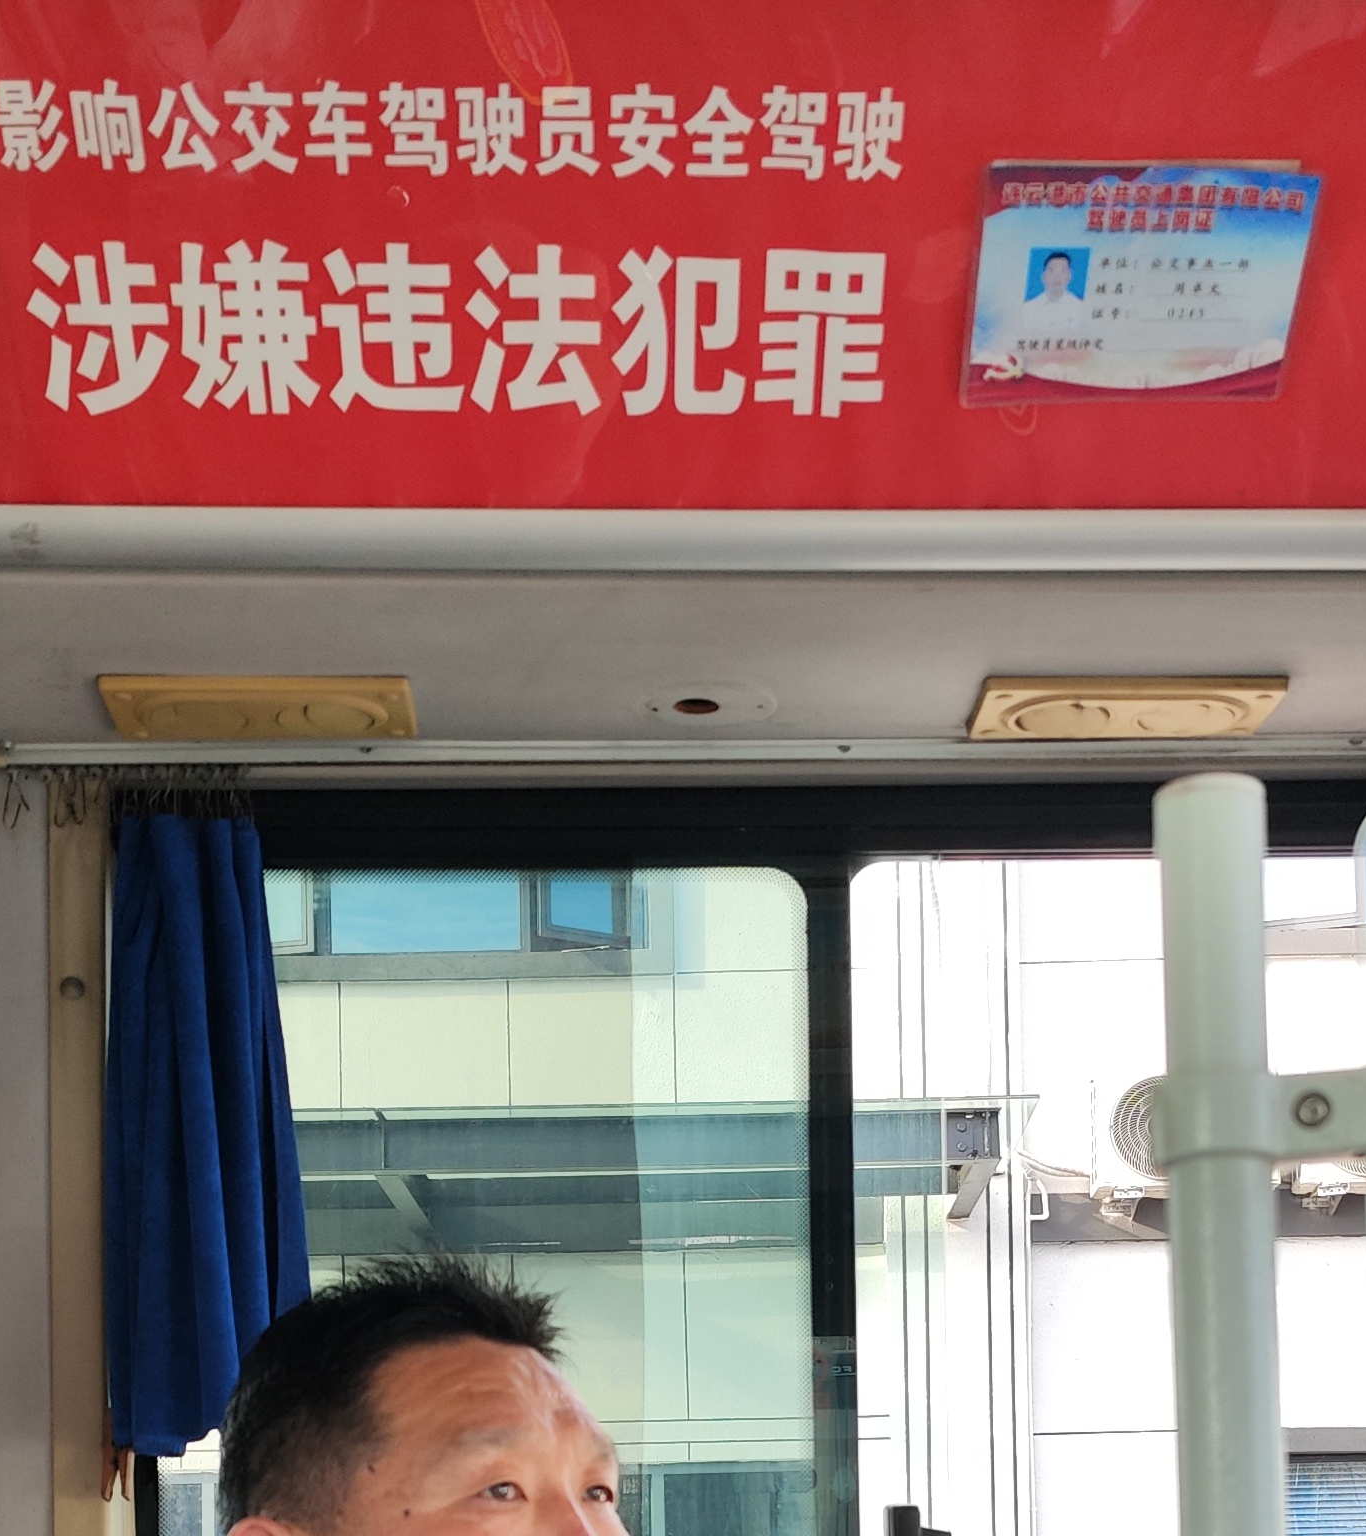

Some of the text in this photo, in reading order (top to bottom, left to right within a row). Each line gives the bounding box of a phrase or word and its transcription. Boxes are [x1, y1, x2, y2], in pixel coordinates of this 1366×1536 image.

[26, 239, 887, 419] 涉嫌违法犯罪
